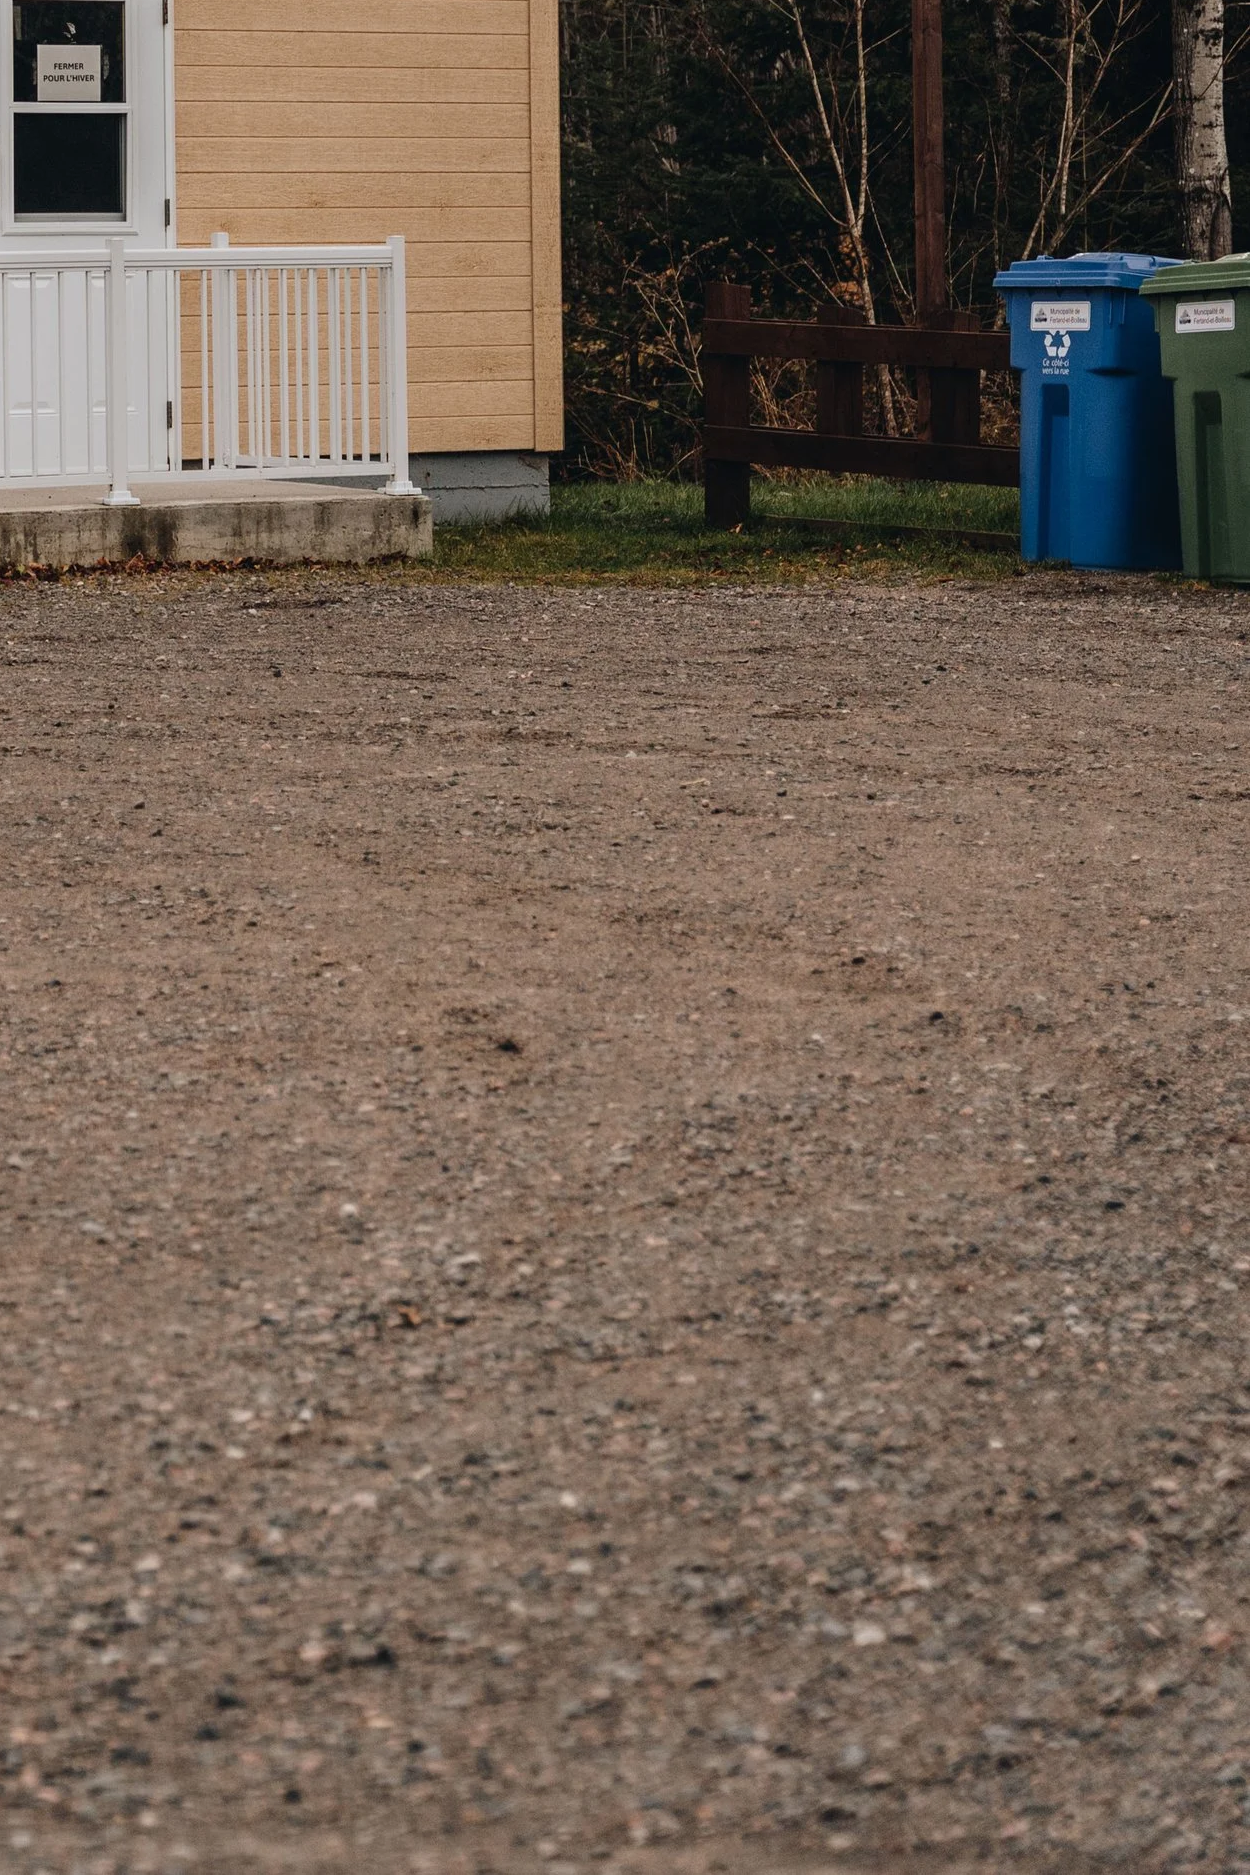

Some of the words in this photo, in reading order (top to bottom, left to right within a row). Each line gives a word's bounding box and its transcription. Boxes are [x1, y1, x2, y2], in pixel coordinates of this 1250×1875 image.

[53, 62, 84, 70] FERMER
[43, 74, 65, 82] POUR
[66, 74, 95, 82] L'HIVER
[1051, 359, 1069, 367] côté-ci
